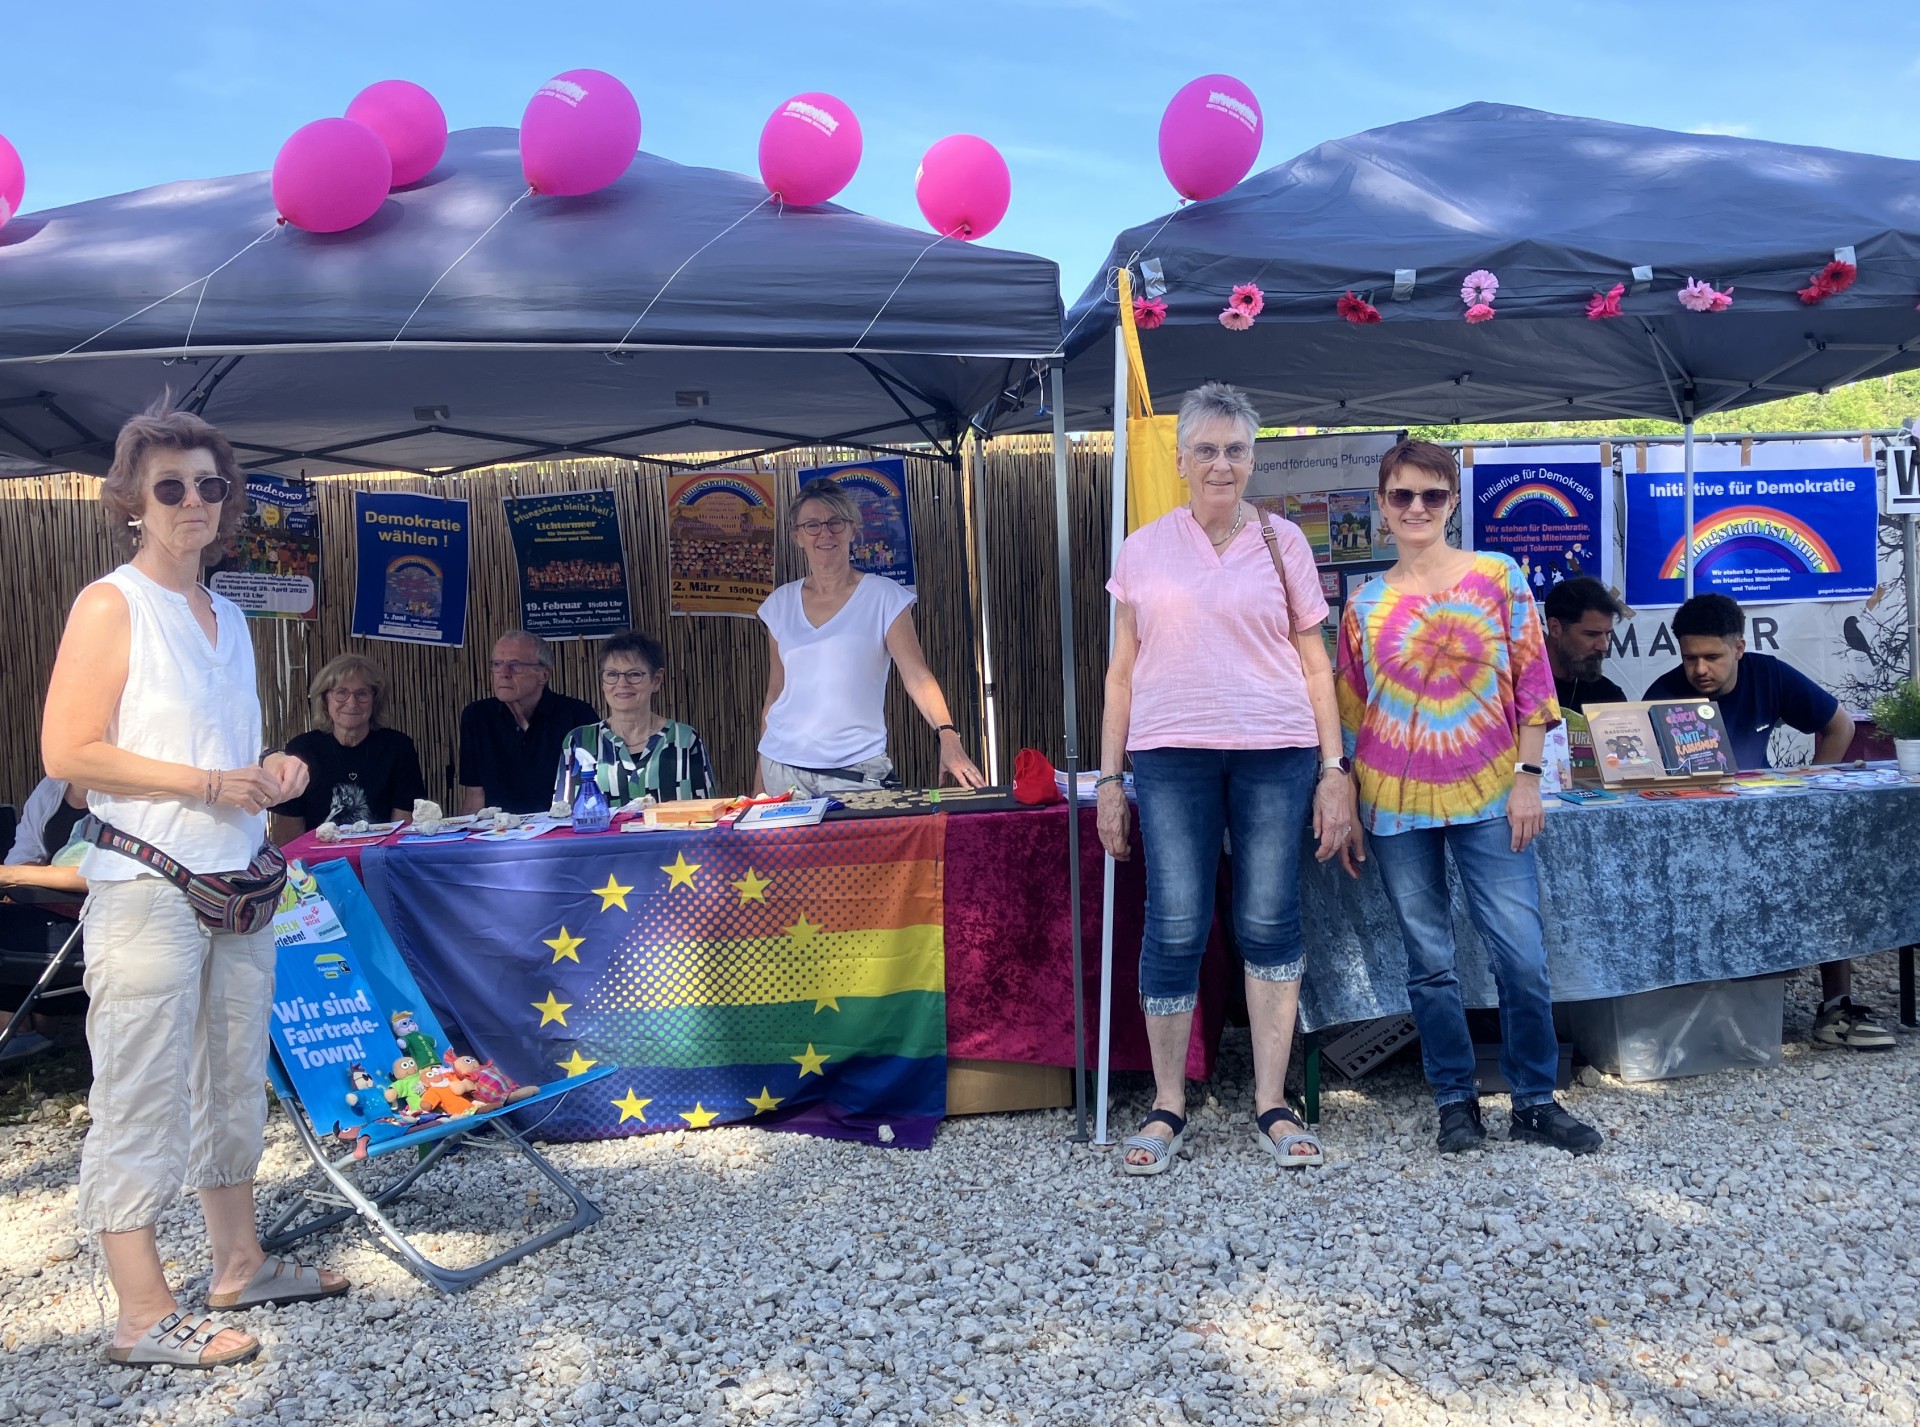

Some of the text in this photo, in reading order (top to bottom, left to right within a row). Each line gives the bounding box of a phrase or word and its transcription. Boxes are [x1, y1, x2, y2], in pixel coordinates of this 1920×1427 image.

[246, 483, 303, 500] rradcorso
[1478, 467, 1594, 504] Initiative für Demokratie
[1649, 478, 1856, 498] Inititive für Demokratie
[1543, 492, 1553, 501] ist
[1553, 496, 1571, 515] bunt
[365, 511, 461, 532] Demokratie
[513, 504, 562, 524] Pfungstadt
[563, 502, 590, 511] bleibt
[591, 504, 609, 517] hell
[536, 521, 597, 531] Lichtermeer
[1485, 523, 1591, 533] Wir stehen für Demokratie,
[378, 529, 448, 547] wählen !
[1485, 533, 1590, 543] ein friedliches Miteinander
[1676, 520, 1825, 572] Pungstadt ist bunt
[1529, 544, 1563, 552] Toleranz
[271, 586, 288, 594] April
[673, 581, 773, 597] 2. März 15:00 Uhr
[525, 602, 541, 611] 19.
[543, 601, 582, 610] Februar
[575, 616, 600, 624] Zeichen
[1604, 616, 1780, 659] MAR
[1672, 710, 1697, 723] BUCH
[1675, 738, 1719, 756] RASSISMUS
[273, 990, 372, 1024] Wir sind
[283, 1019, 380, 1047] Fairtrade-
[291, 1037, 367, 1070] Town!
[1347, 1022, 1416, 1072] pekt!
